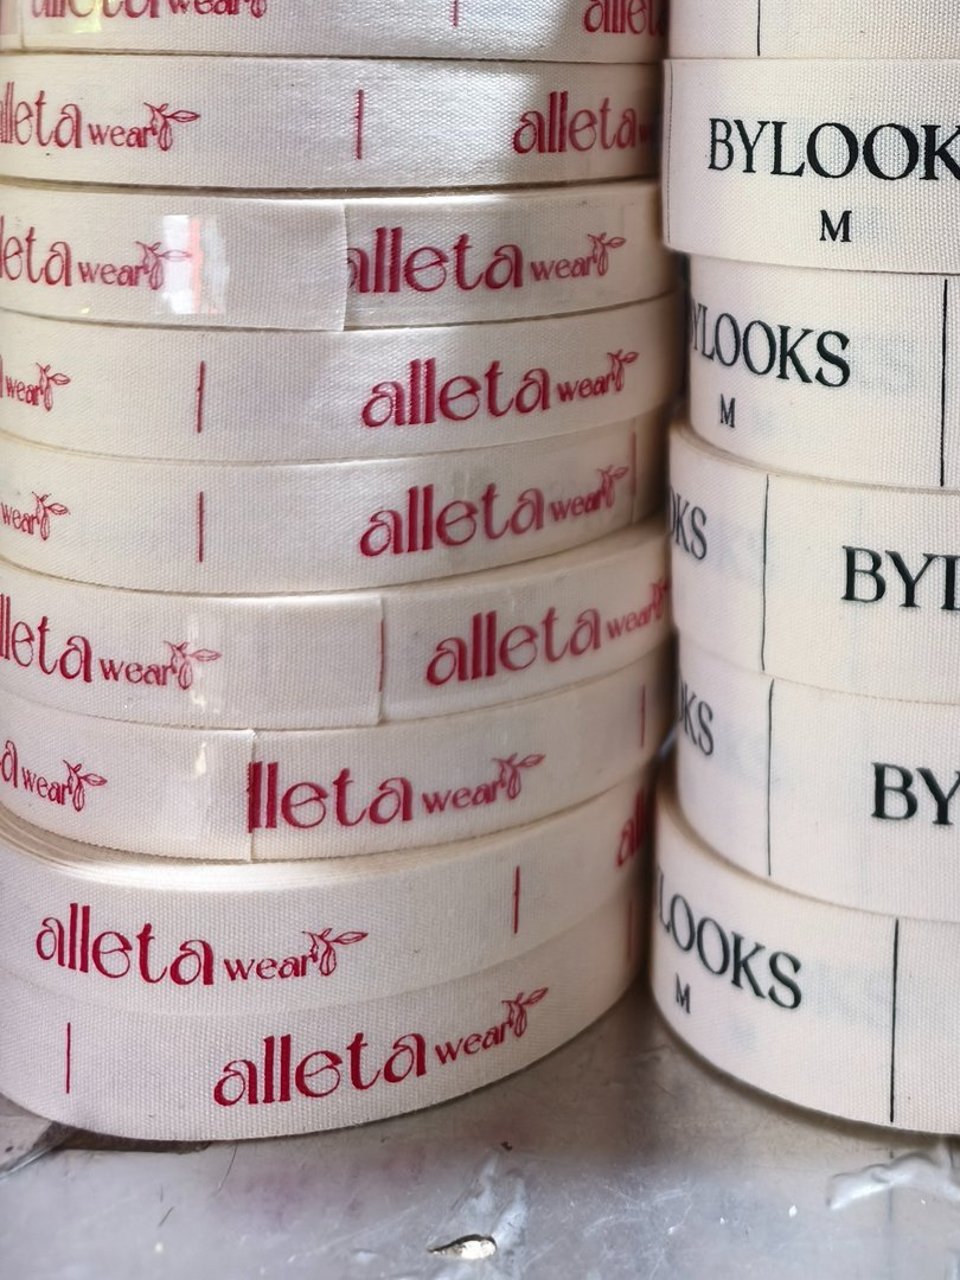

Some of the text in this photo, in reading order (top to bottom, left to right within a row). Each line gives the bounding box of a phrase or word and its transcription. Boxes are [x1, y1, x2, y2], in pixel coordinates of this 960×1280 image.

[0, 81, 156, 149] lleta wear
[513, 91, 636, 154] alleta
[819, 210, 852, 243] M
[78, 261, 148, 287] wear
[531, 251, 594, 281] wear
[362, 358, 618, 427] alleta wear
[720, 394, 735, 428] M
[359, 485, 608, 556] alleta wear
[425, 612, 601, 686] alleta
[99, 657, 175, 686] wear
[22, 766, 71, 805] wear
[422, 786, 502, 815] wear
[36, 903, 320, 985] alleta wear
[676, 972, 690, 1014] M
[213, 1023, 511, 1107] alleta wear
